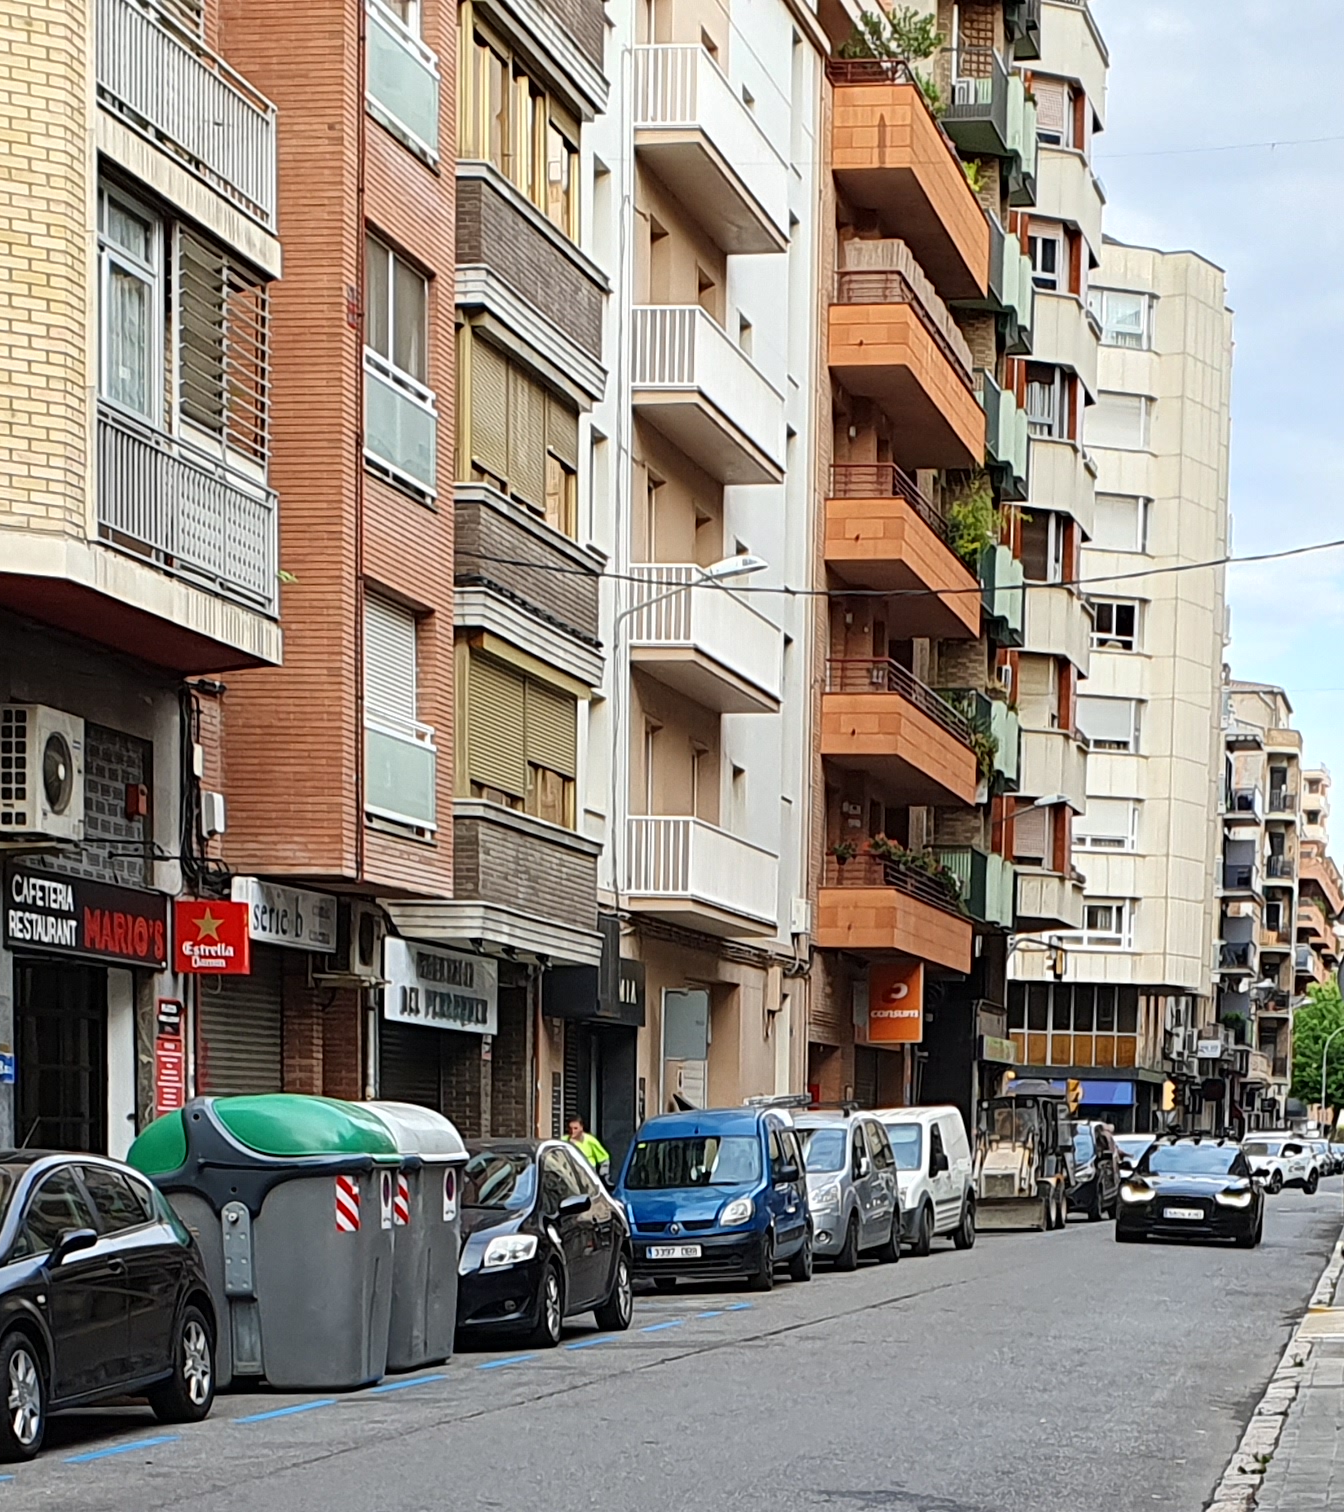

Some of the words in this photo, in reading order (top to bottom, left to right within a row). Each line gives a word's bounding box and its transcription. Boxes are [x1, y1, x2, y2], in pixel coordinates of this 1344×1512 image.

[11, 873, 75, 912] CAFETERIA
[8, 908, 77, 947] RESTAURANT
[83, 906, 164, 959] MARIO'S
[182, 941, 234, 957] Estrella
[870, 1009, 919, 1019] consum
